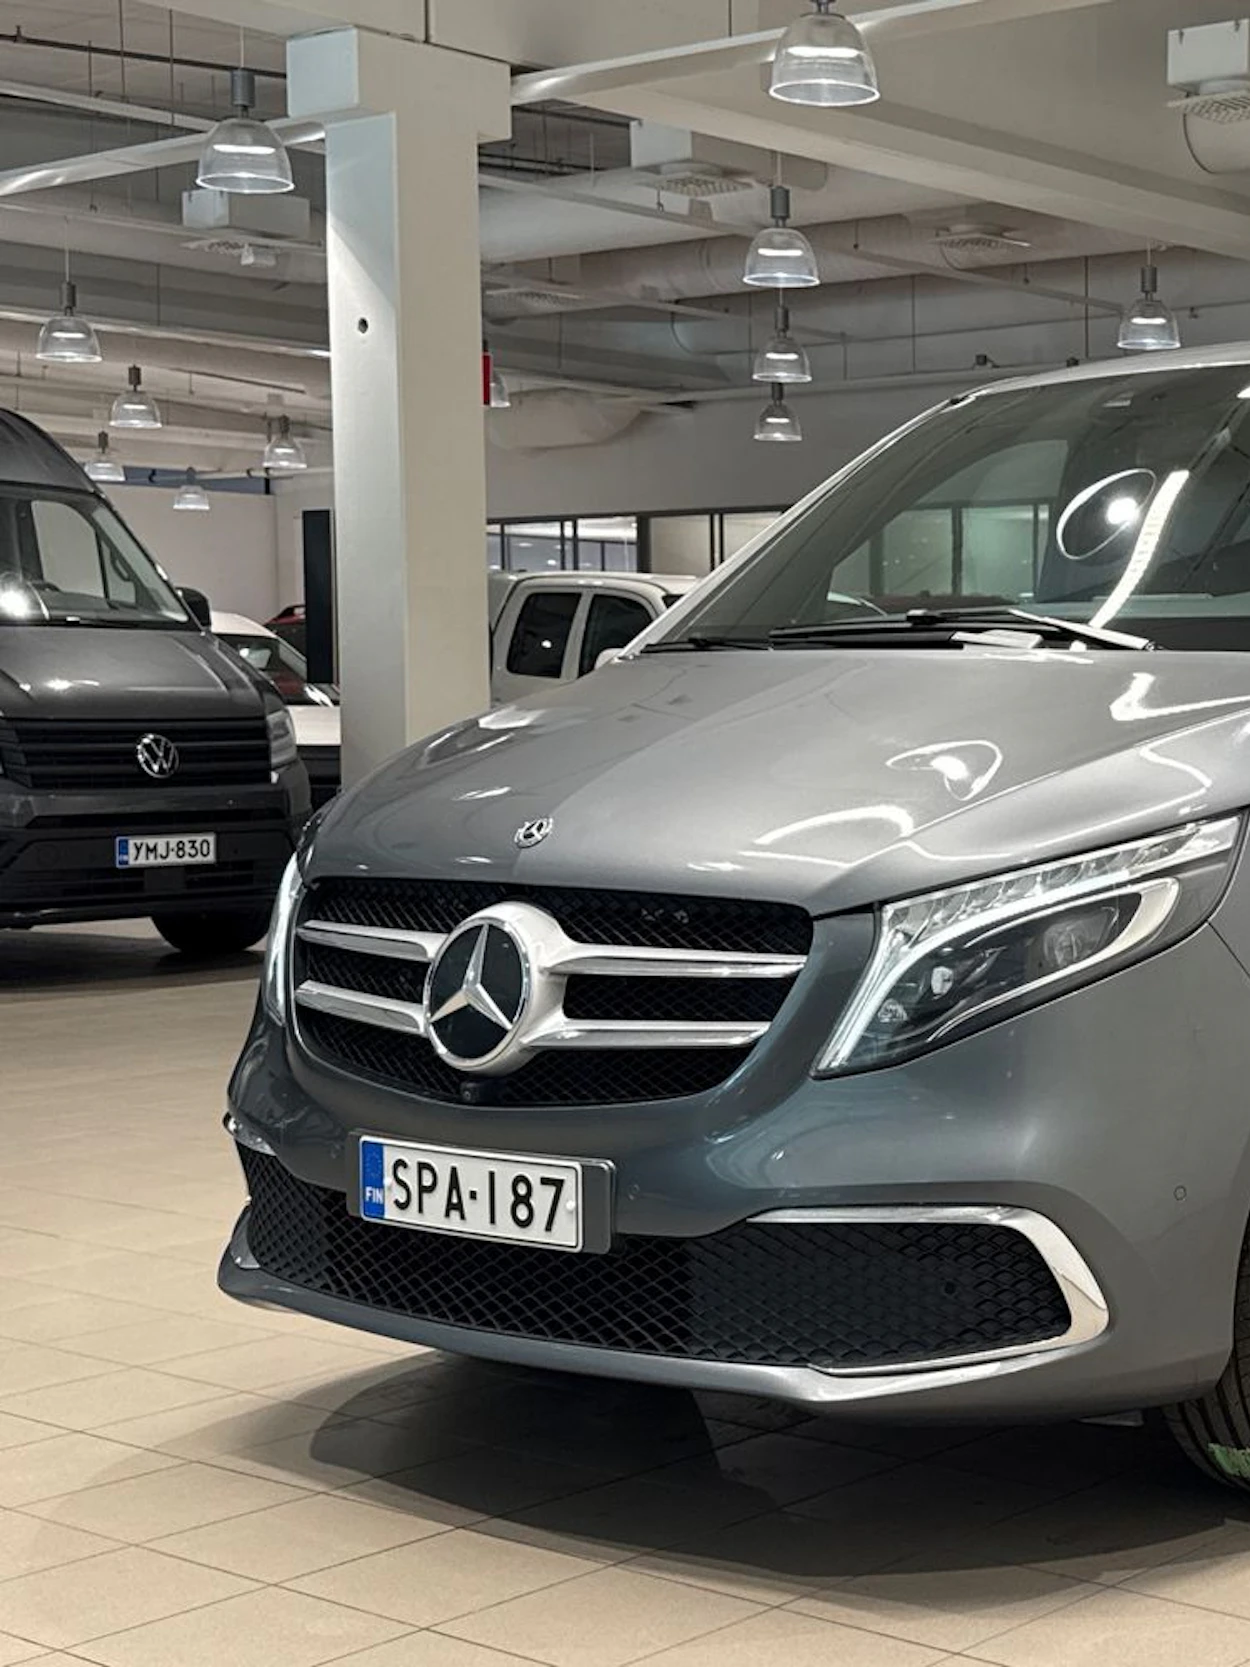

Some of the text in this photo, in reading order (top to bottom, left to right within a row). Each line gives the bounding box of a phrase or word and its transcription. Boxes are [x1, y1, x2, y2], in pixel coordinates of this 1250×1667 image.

[133, 839, 210, 861] YMJ-830
[366, 1186, 383, 1203] FIN
[392, 1158, 565, 1232] SPA-187
